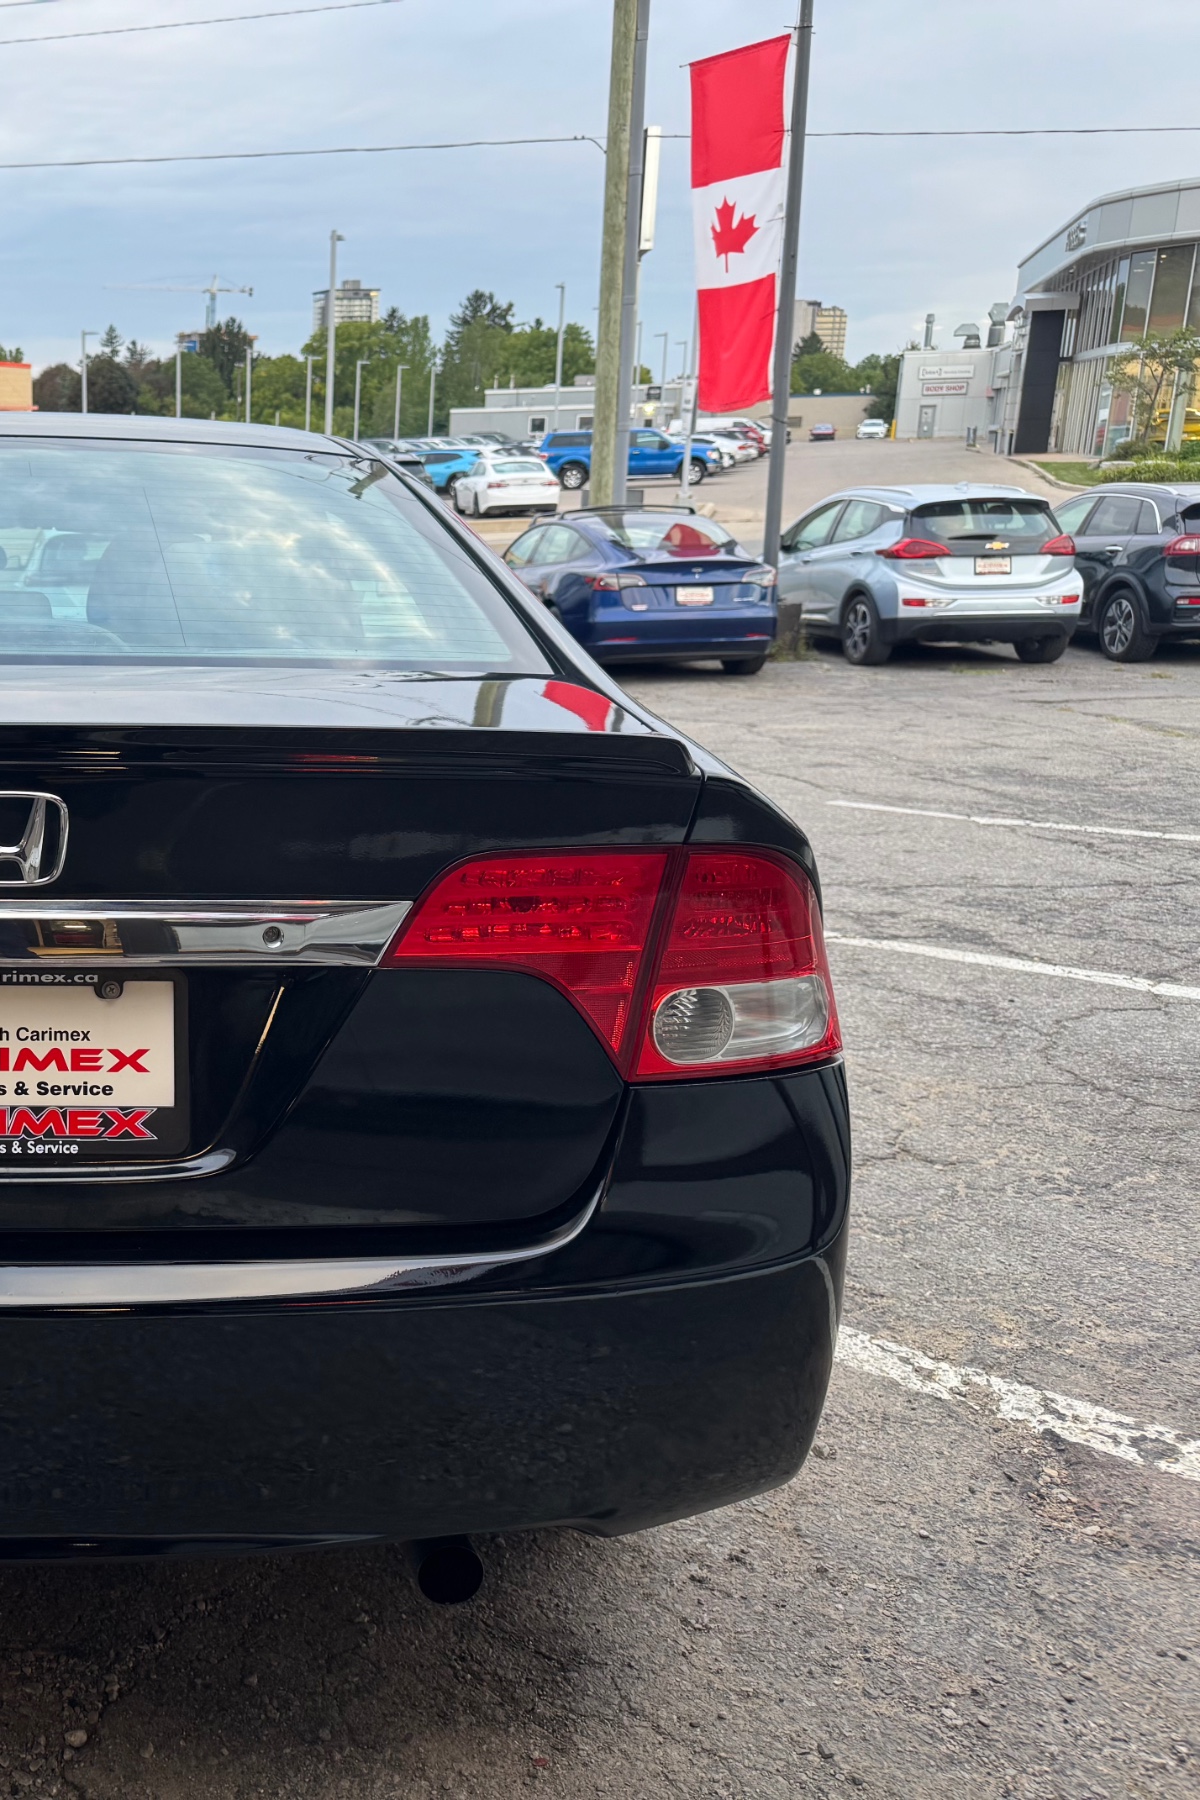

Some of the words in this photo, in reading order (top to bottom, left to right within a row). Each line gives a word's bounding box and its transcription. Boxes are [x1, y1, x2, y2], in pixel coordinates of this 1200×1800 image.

[945, 384, 965, 392] SHOP
[15, 1027, 91, 1042] Carimex
[14, 1082, 29, 1096] &
[36, 1081, 114, 1096] Service
[11, 1141, 23, 1155] &
[26, 1141, 79, 1155] Service
